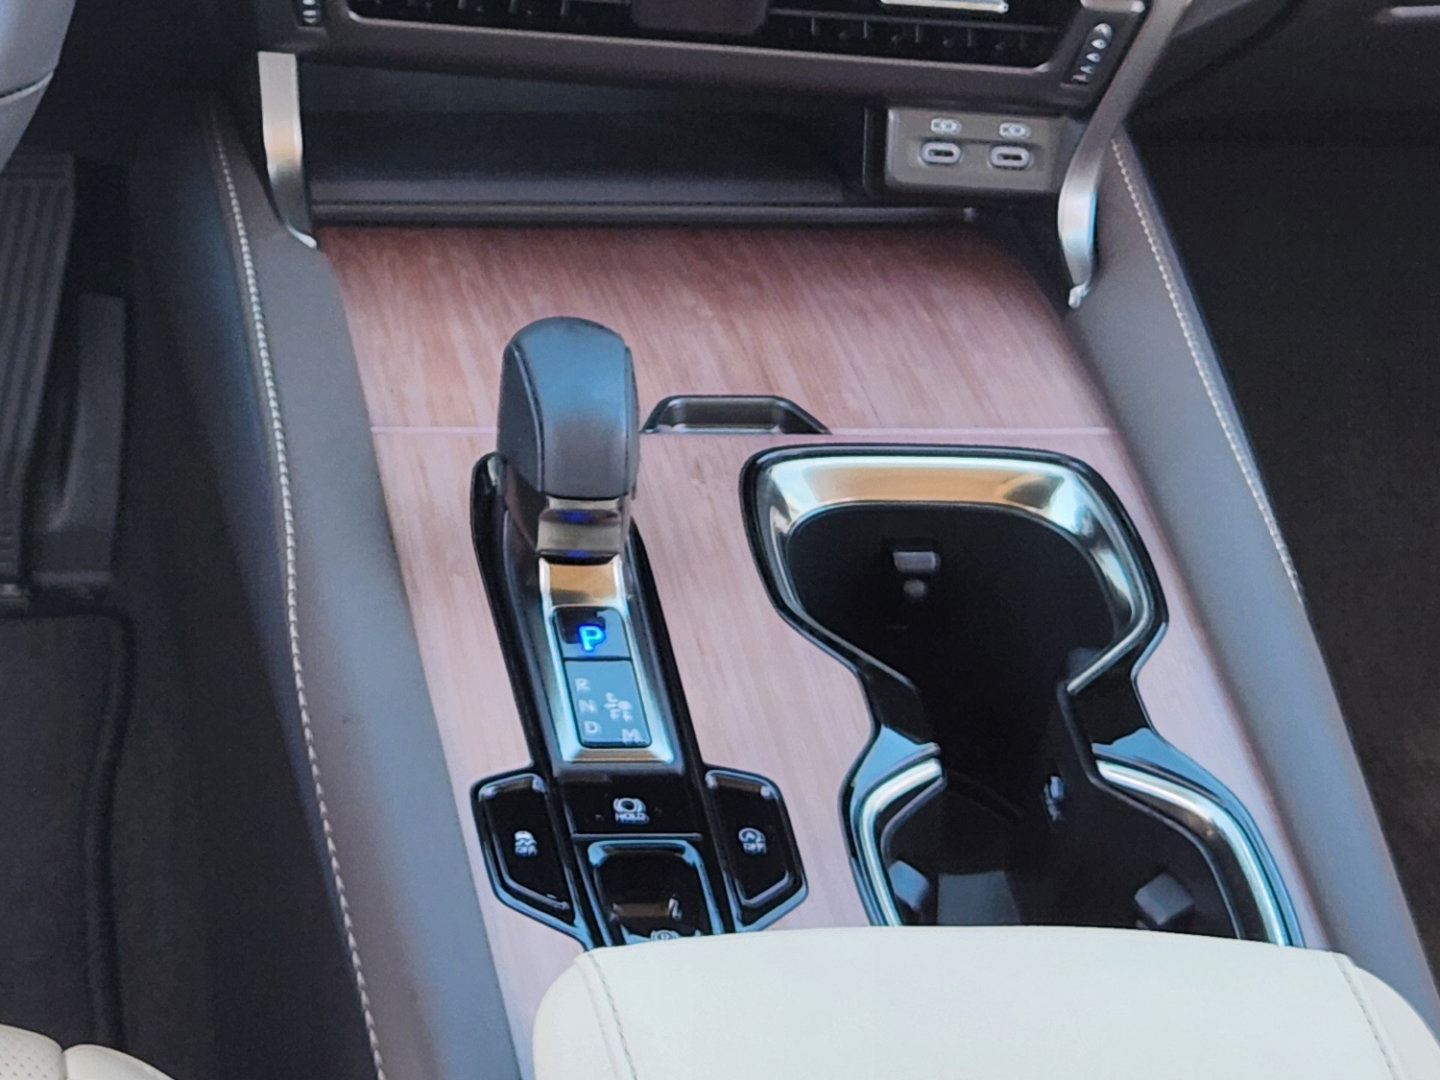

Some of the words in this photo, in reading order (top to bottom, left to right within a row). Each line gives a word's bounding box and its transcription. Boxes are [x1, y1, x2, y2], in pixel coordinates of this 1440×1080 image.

[578, 624, 606, 651] P
[575, 678, 591, 691] R
[579, 699, 597, 713] N
[584, 721, 601, 735] D
[620, 728, 641, 743] M
[614, 812, 649, 824] HOLD
